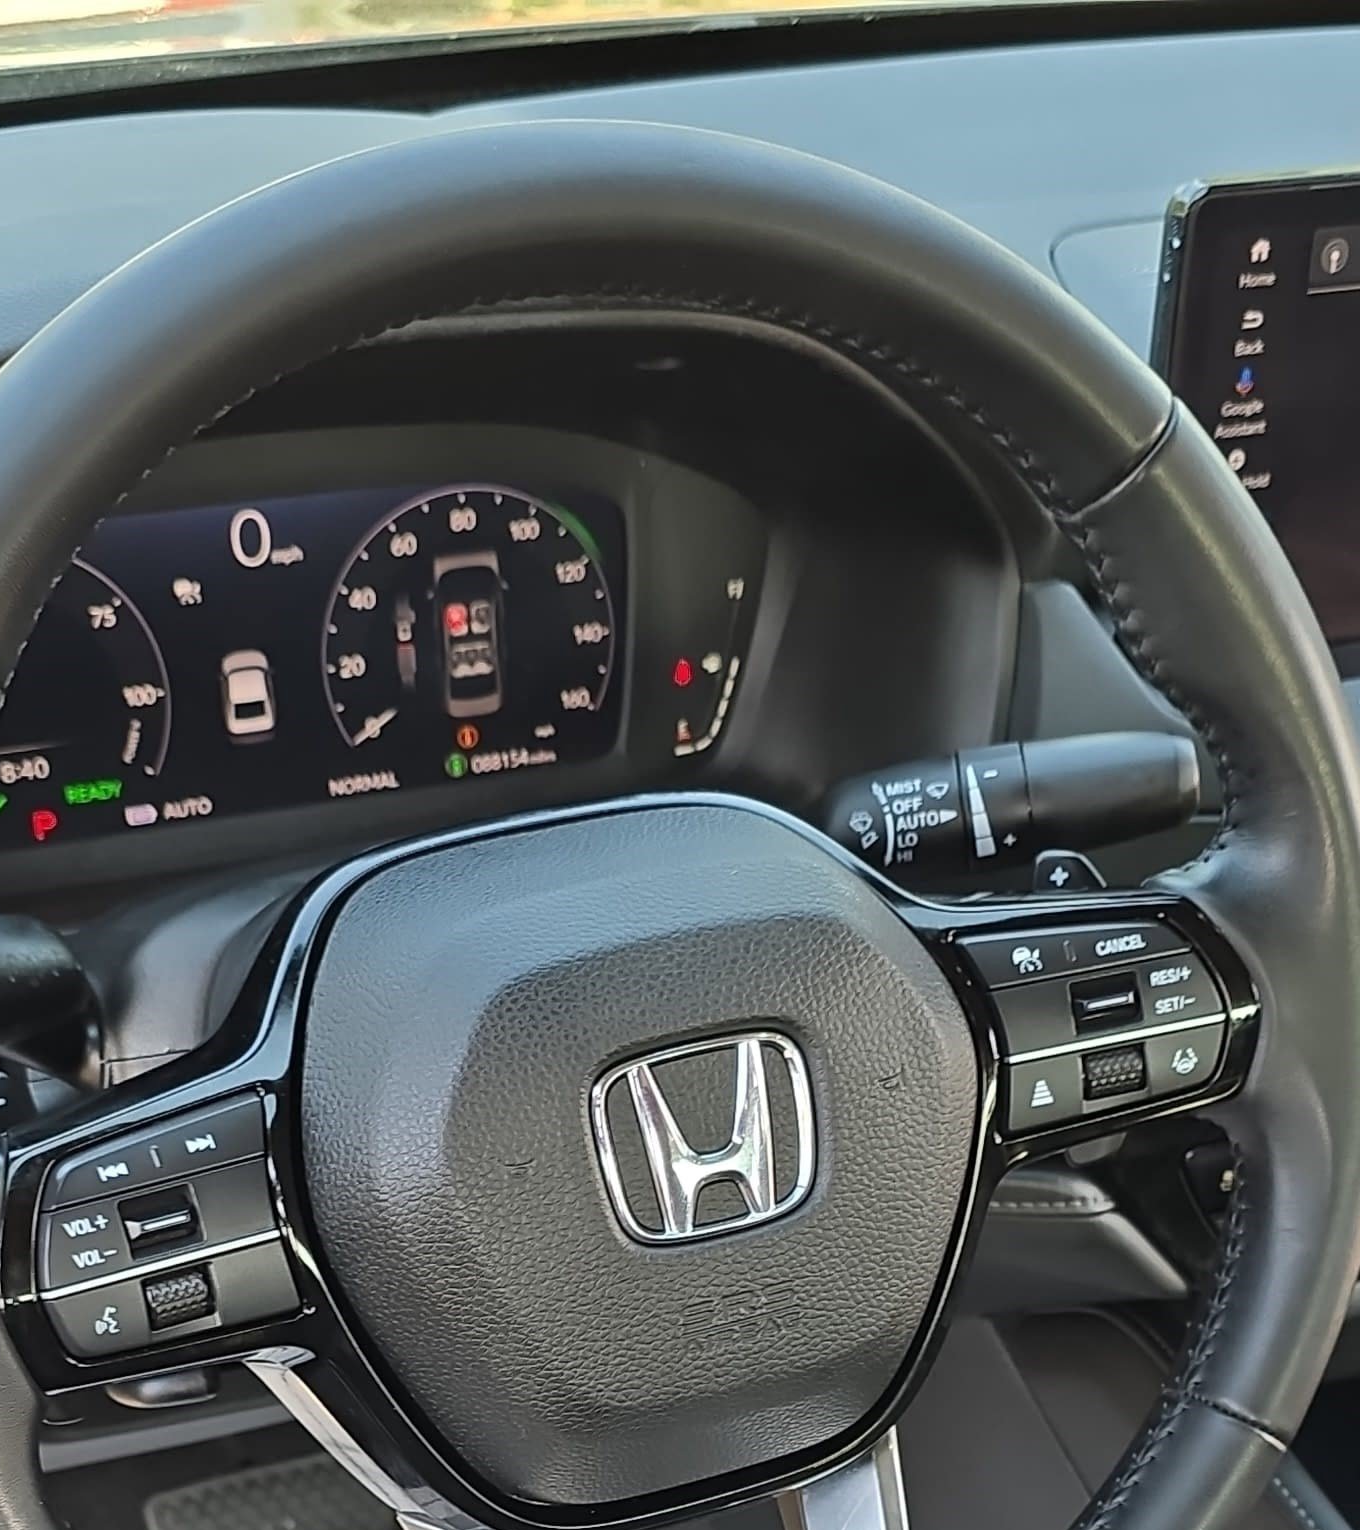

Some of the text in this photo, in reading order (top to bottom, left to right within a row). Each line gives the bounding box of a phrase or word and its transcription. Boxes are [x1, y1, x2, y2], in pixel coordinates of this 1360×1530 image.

[1239, 272, 1276, 289] Home
[1234, 339, 1265, 357] Back
[1221, 401, 1264, 417] Google
[449, 507, 476, 532] 80
[509, 517, 540, 541] 100
[230, 507, 272, 568] 0
[390, 532, 417, 556] 60
[555, 560, 586, 584] 120
[349, 587, 376, 610] 40
[88, 604, 117, 629] 75
[339, 655, 365, 679] 20
[122, 683, 157, 707] 100
[63, 779, 123, 804] READY
[328, 771, 400, 797] NORMAL
[886, 778, 921, 797] MIST
[163, 796, 213, 820] AUTO
[892, 797, 923, 815] OFF
[32, 809, 57, 841] P
[896, 810, 939, 832] AUTO
[897, 832, 919, 849] LO
[1095, 933, 1147, 957] CANCEL
